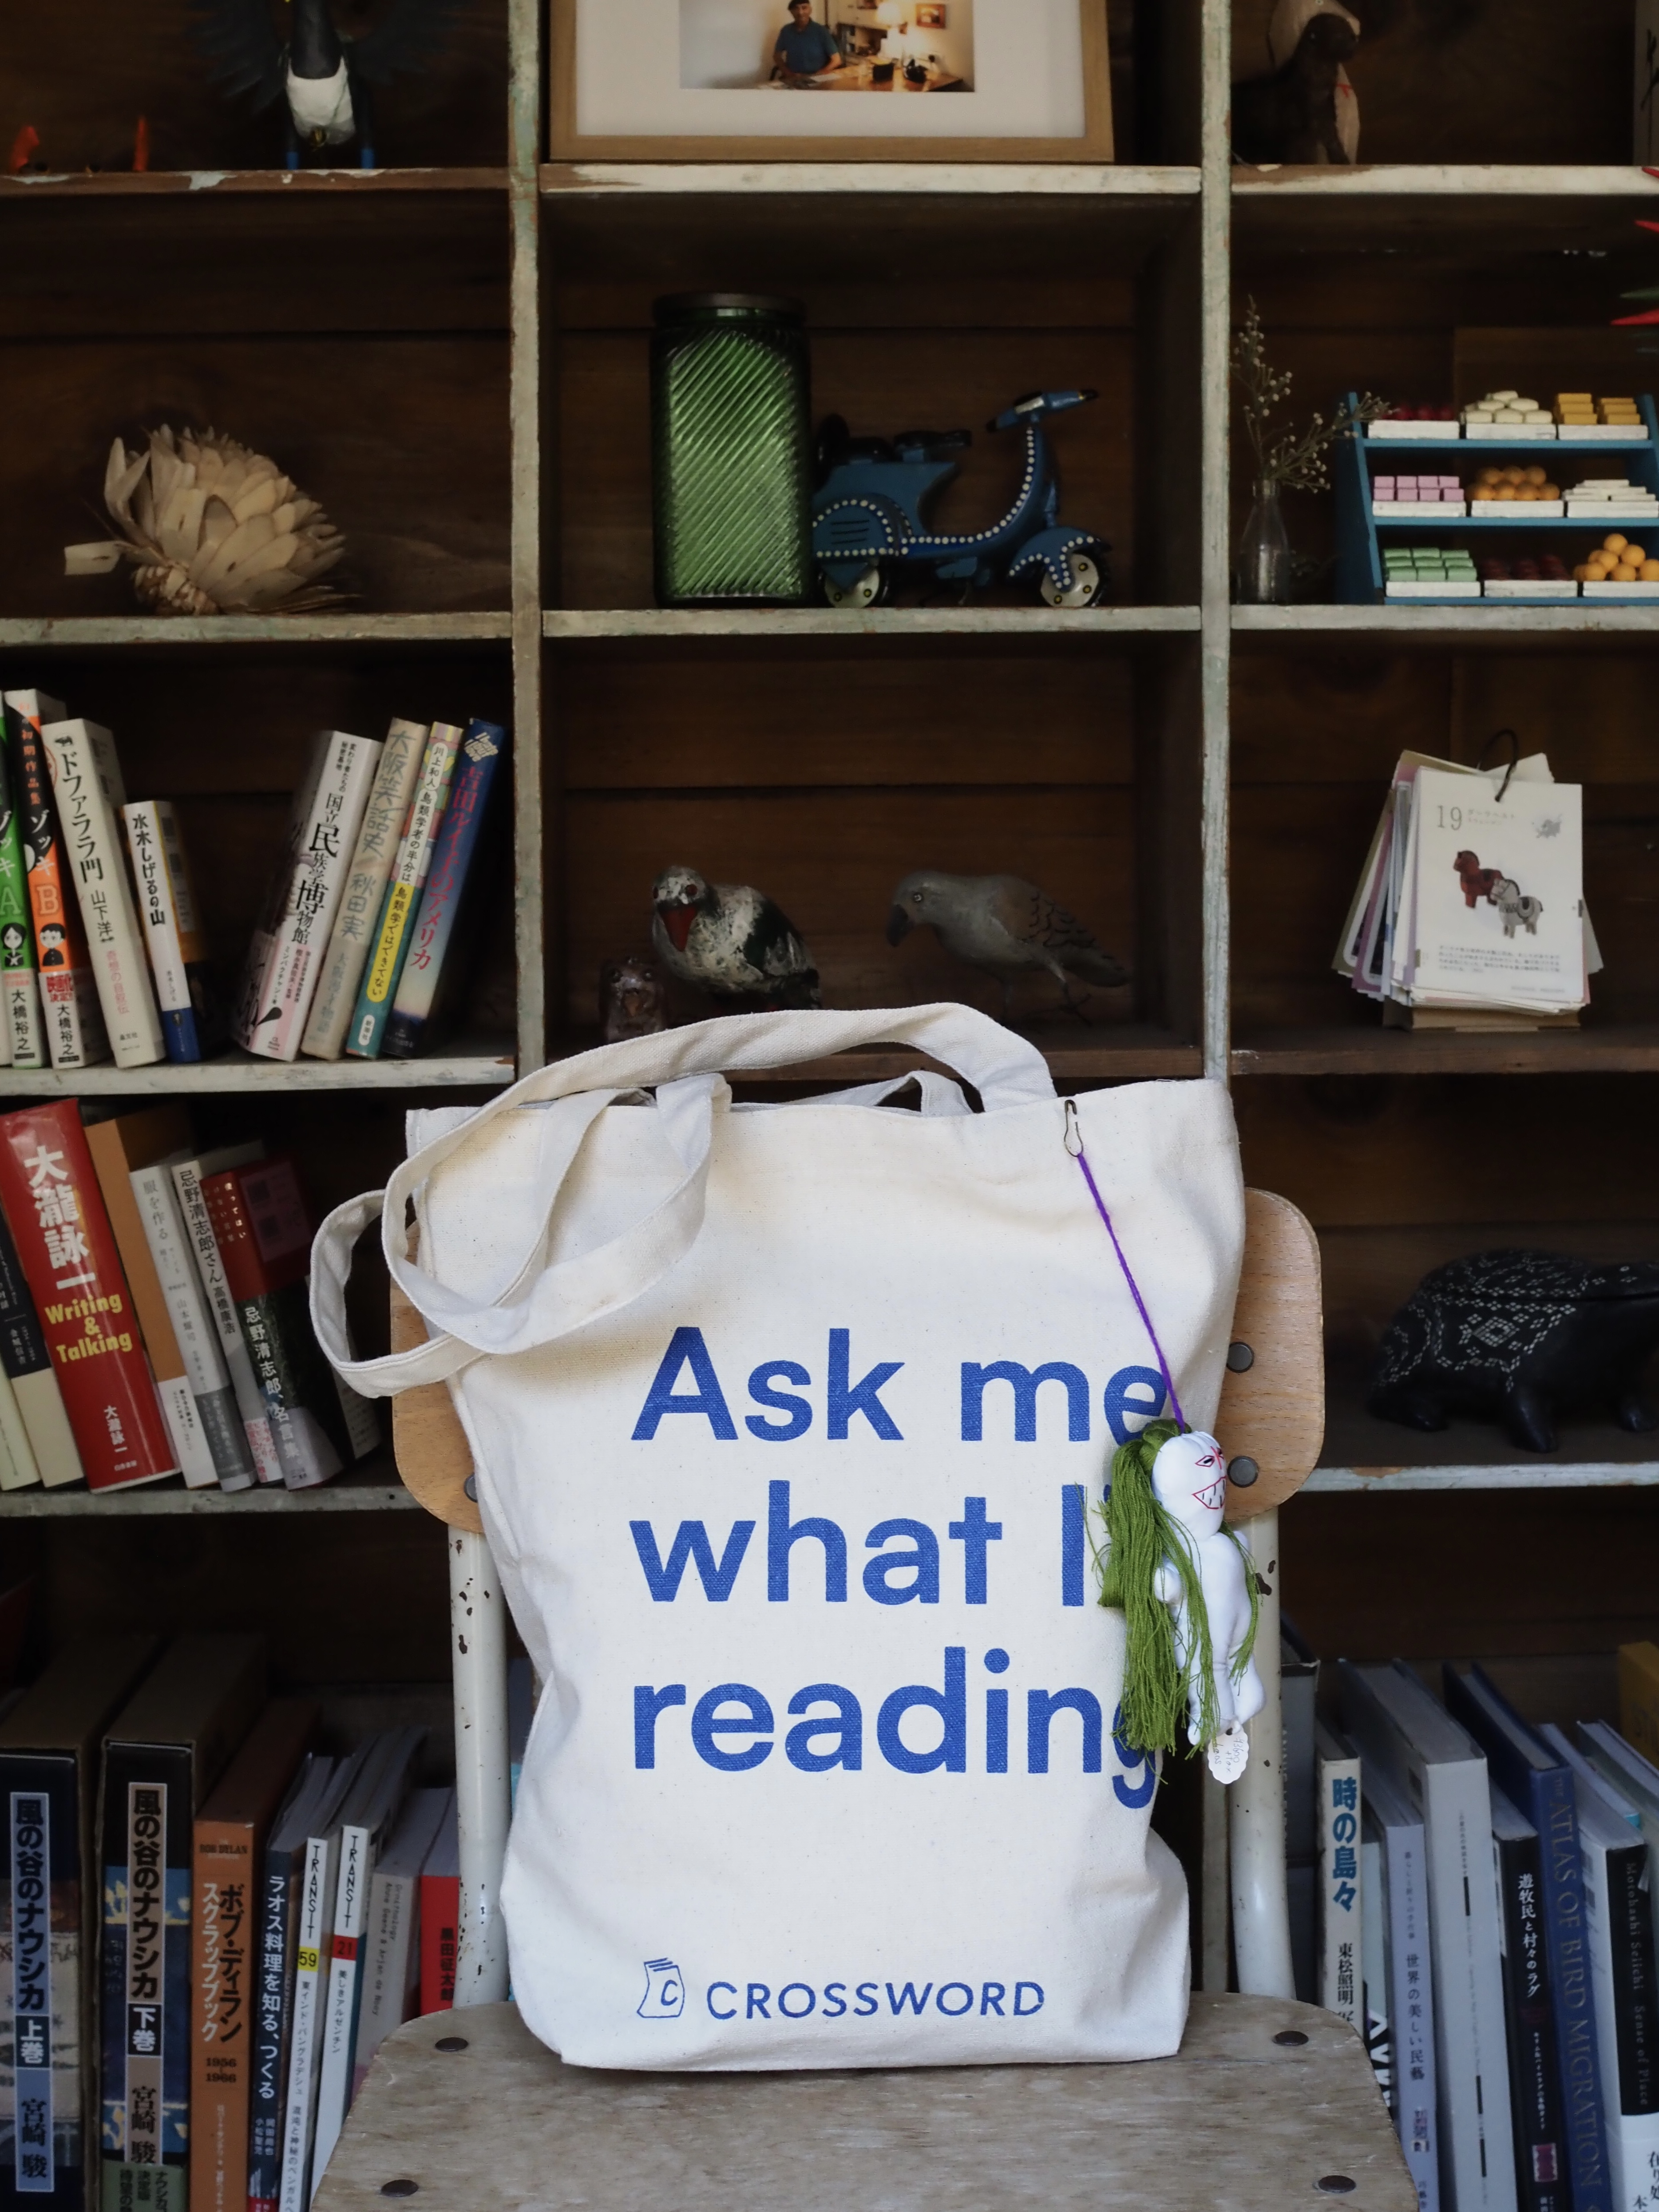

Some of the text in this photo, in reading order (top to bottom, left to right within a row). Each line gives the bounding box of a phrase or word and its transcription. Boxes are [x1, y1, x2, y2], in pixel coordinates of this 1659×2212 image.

[61, 752, 104, 883] ドファララ門
[132, 814, 166, 926] 水木しげるの山
[291, 793, 344, 945] 国立民族学博物館
[1437, 805, 1462, 831] 19
[37, 885, 59, 915] B
[12, 989, 30, 1051] 大橋裕之
[57, 1004, 74, 1055] 大橋裕之
[24, 1145, 96, 1290] 大瀧詠一
[179, 1169, 222, 1283] 忌野清志郎さん
[44, 1294, 123, 1325] Writing
[56, 1333, 133, 1364] Talking
[84, 1317, 102, 1336] &
[630, 1326, 1168, 1446] Ask me
[630, 1480, 1003, 1605] what
[634, 1646, 1156, 1808] reading
[131, 1789, 162, 1999] 風の谷のナウシカ
[344, 1835, 358, 1929] TRANSIT
[1332, 1777, 1358, 1912] 時の島々
[1549, 1802, 1577, 1883] ATLAS
[16, 1799, 45, 2011] 風の谷のナウシカ
[298, 1845, 321, 1968] TRANSIT 59
[1517, 1873, 1540, 1999] 遊牧民と村々のラグ
[1557, 1891, 1581, 1929] OF
[202, 1883, 219, 2043] スクラップブック
[219, 1883, 245, 2043] ボブ・ディラン
[258, 1875, 285, 2099] ラオス料理を知る、つくる
[707, 1981, 1045, 2020] CROSSWORD
[1338, 1942, 1354, 2005] 東松照明
[1559, 1938, 1587, 2009] BIRD
[20, 2019, 44, 2065] 上巻
[132, 2007, 156, 2053] 下巻
[1567, 2019, 1602, 2187] MIGRATION
